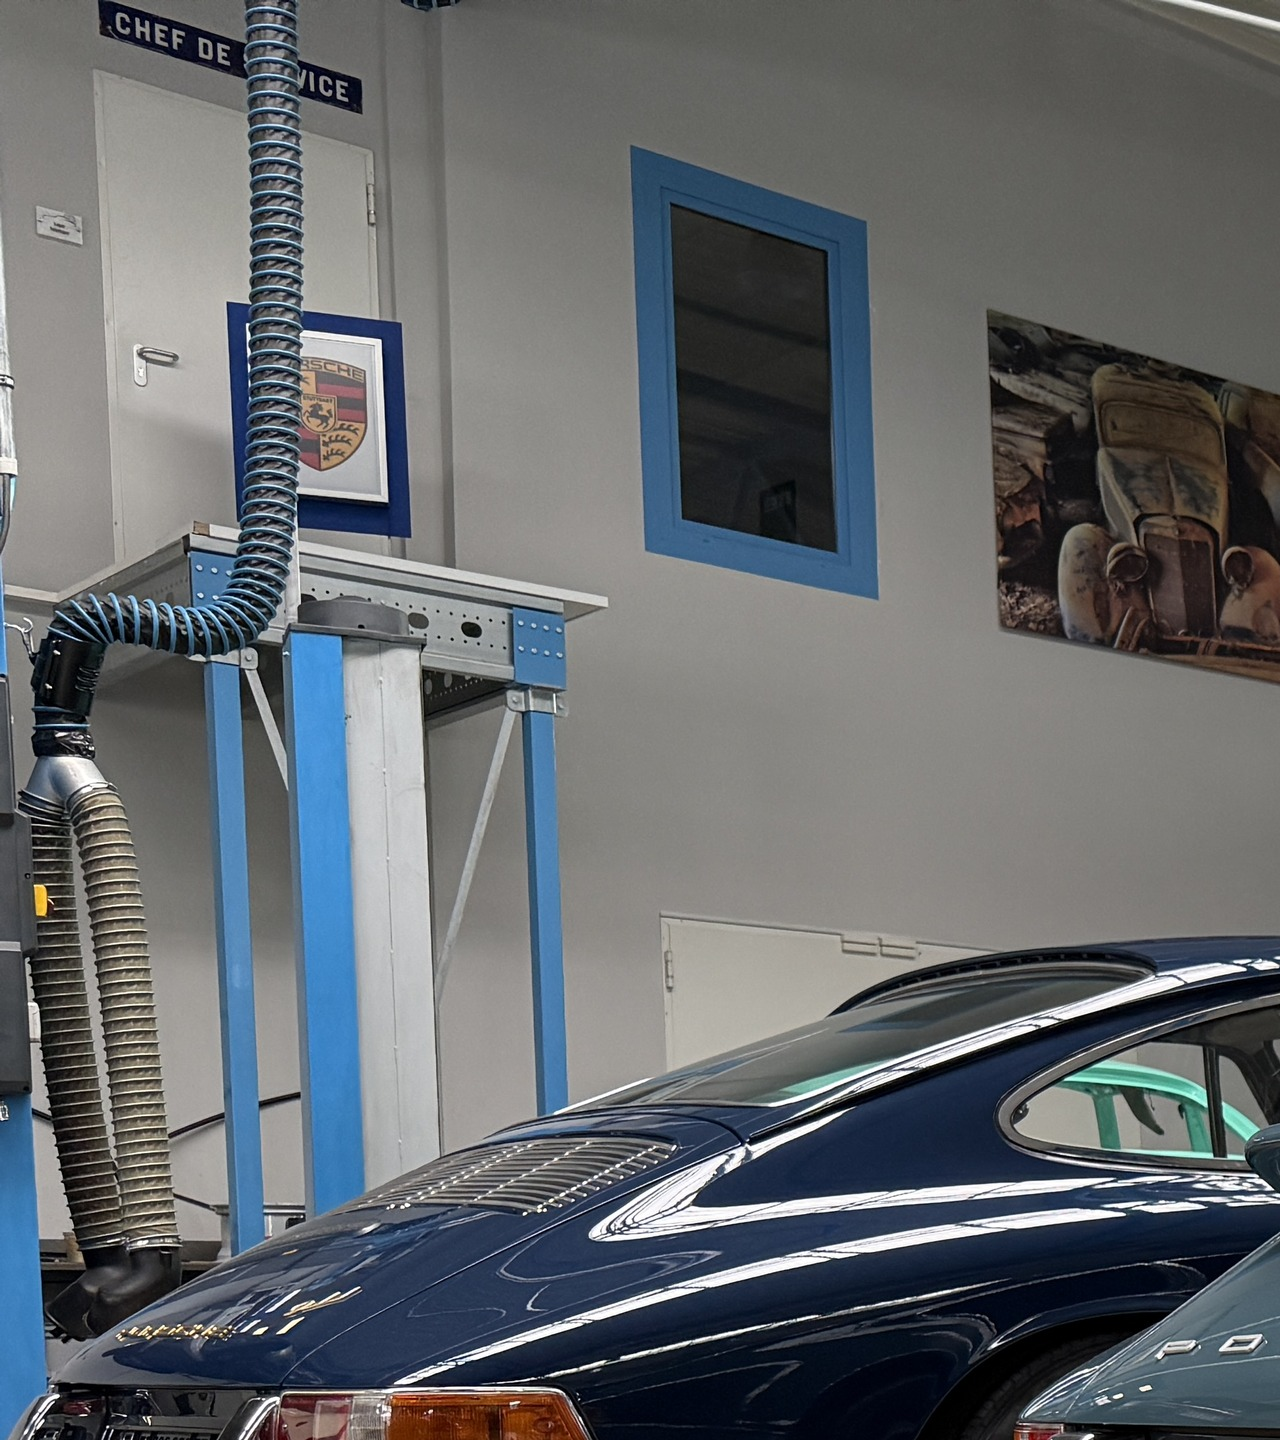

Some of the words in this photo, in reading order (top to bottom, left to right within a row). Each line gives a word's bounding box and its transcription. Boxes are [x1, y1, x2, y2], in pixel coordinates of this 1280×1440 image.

[114, 12, 186, 51] CHEF
[198, 36, 231, 67] DE
[301, 358, 365, 384] RSCHE
